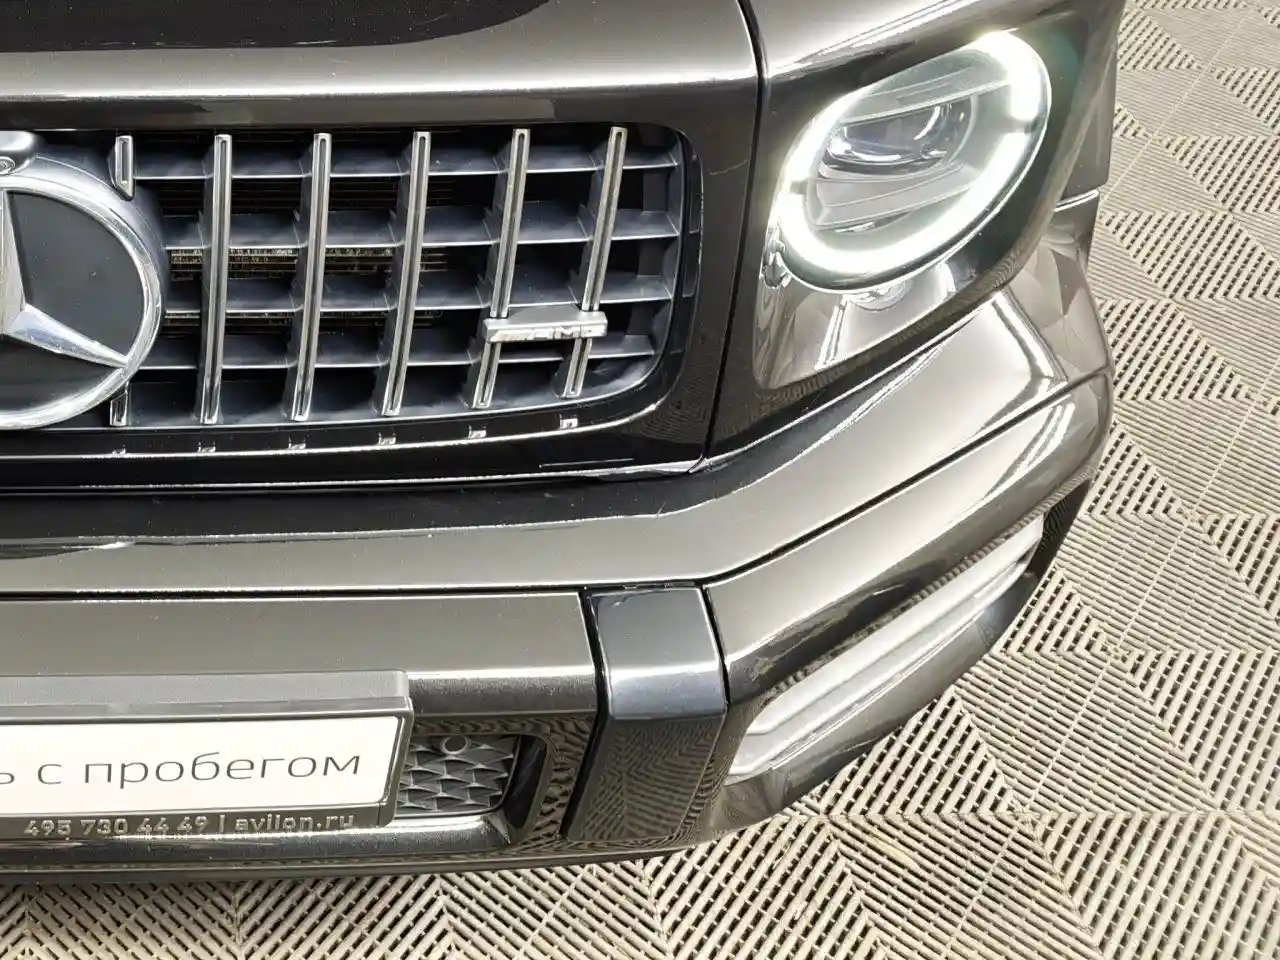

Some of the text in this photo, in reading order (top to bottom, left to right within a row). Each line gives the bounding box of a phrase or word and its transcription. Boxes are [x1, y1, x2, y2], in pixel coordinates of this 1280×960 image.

[37, 762, 62, 785] с
[83, 751, 361, 789] пробегом
[23, 818, 72, 837] 495
[79, 818, 128, 836] 730
[136, 817, 169, 835] 44
[176, 814, 209, 833] 49
[234, 812, 356, 832] avilon.ru
